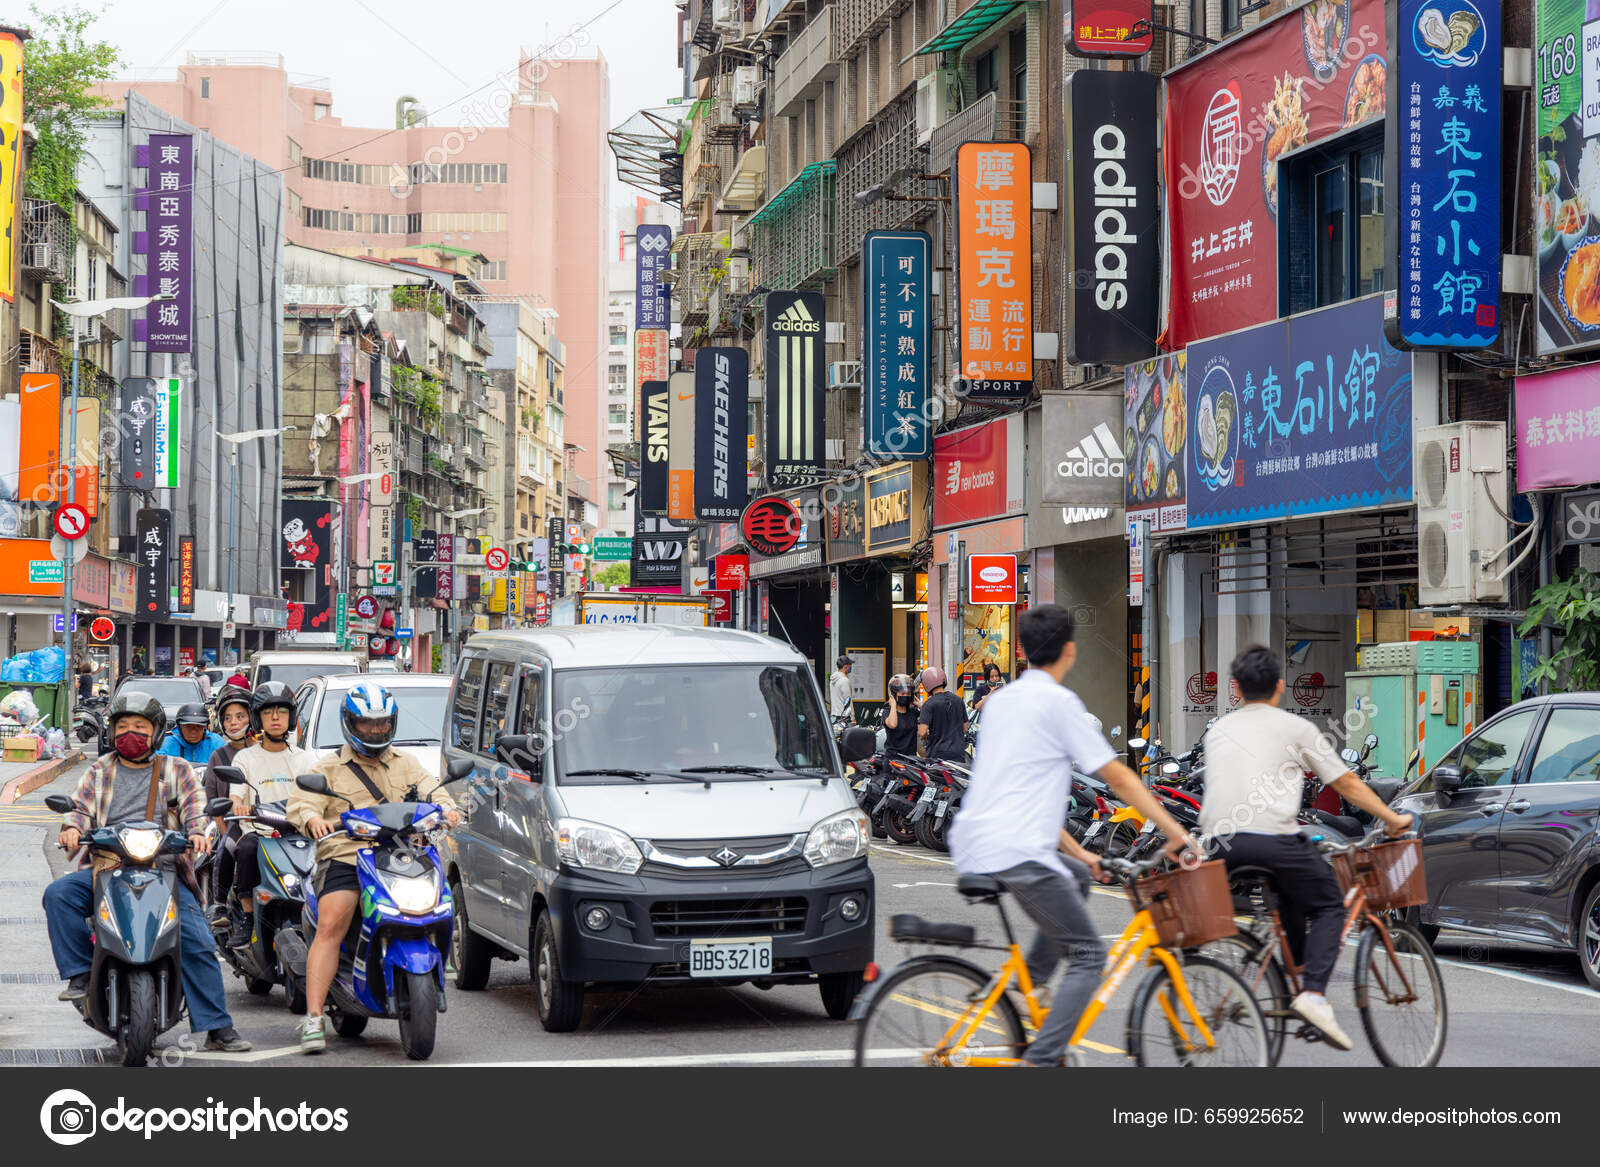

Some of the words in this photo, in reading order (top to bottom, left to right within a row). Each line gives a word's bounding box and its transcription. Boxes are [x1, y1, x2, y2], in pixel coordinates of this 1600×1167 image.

[1538, 32, 1576, 84] 168
[1432, 84, 1487, 112] 嘉義
[1541, 83, 1560, 109] 元起
[1410, 81, 1421, 169] 台灣鮮蚵的故鄉
[158, 145, 180, 327] 東南亞秀泰影城
[975, 150, 1015, 288] 摩瑪克
[1093, 124, 1137, 311] adidas
[1433, 115, 1482, 316] 東石小館
[772, 319, 820, 332] adidas
[879, 283, 887, 325] KEBUKE
[968, 299, 991, 352] 運動
[1002, 299, 1025, 352] 流行
[879, 334, 887, 355] TEA
[897, 255, 916, 437] 可不可熟成紅茶
[879, 357, 887, 407] COMPANY
[973, 381, 1021, 391] SPORT
[1257, 344, 1380, 446] 東石小館
[648, 392, 668, 463] VANS
[714, 353, 729, 500] SKECHERS
[1242, 371, 1257, 449] 嘉義
[961, 475, 973, 491] new
[972, 470, 995, 488] balance
[1057, 457, 1124, 478] adida
[701, 508, 740, 517] 摩瑪克9店
[661, 565, 676, 573] Beauty
[693, 948, 770, 970] BBS-3218
